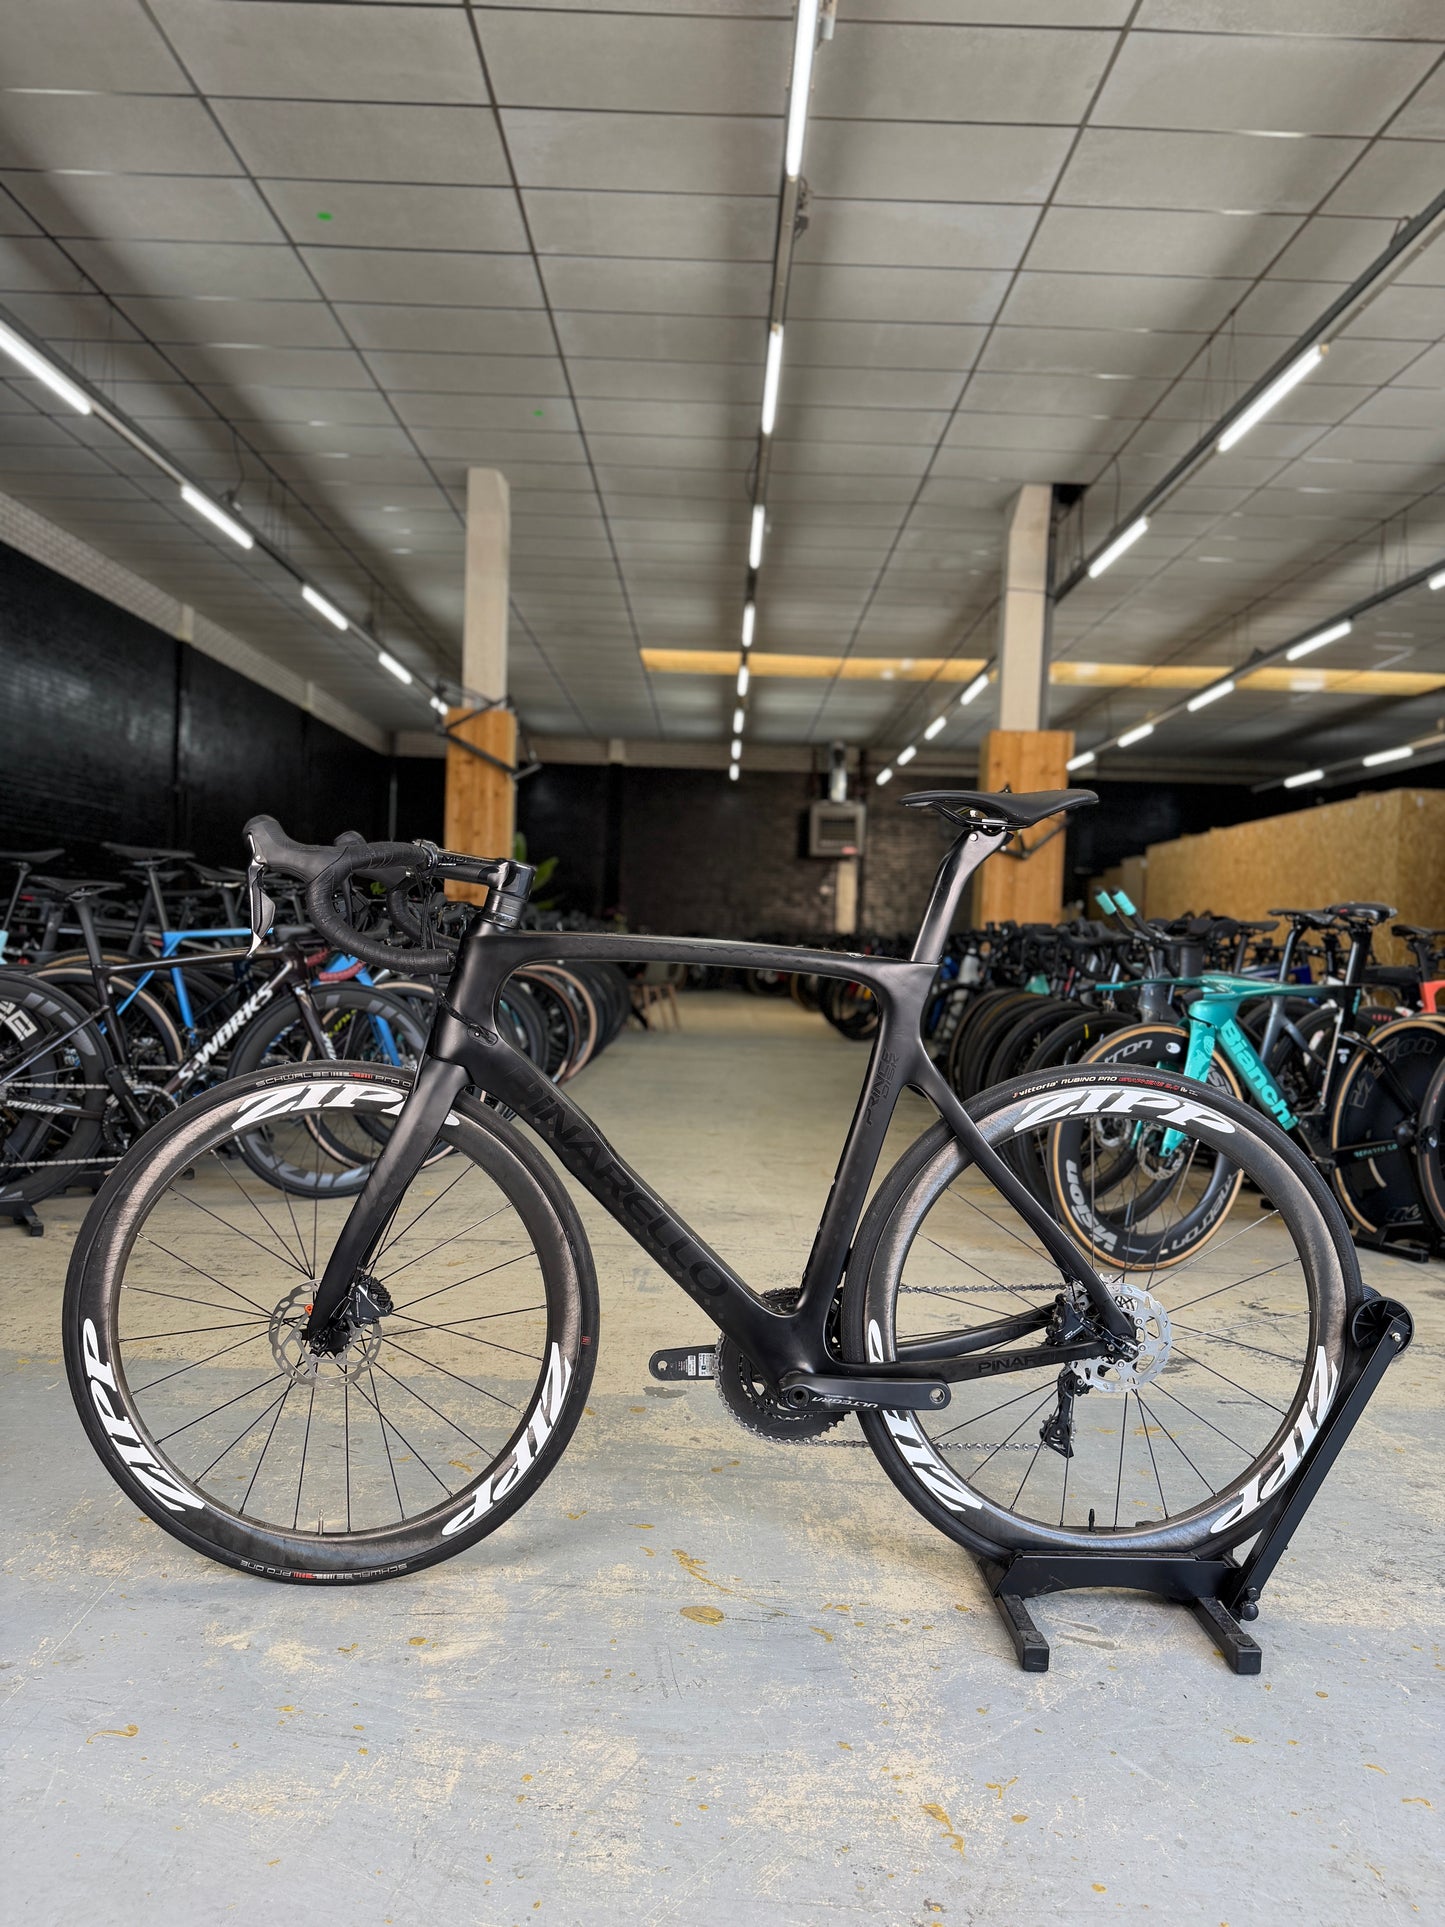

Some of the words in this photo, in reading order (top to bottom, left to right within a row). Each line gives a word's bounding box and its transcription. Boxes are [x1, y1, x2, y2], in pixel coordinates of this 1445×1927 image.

[255, 1071, 330, 1087] SCHWALBE
[1061, 1076, 1096, 1085] RUBINO
[1220, 1018, 1298, 1131] Bianchi
[5, 1099, 65, 1114] SPECIALIZED
[1013, 1088, 1236, 1134] ZIPP
[83, 1317, 205, 1512] ZIPP
[811, 1396, 879, 1409] ULTEGRA
[442, 1342, 572, 1536] ZIPP
[1210, 1345, 1338, 1534] ZIPP
